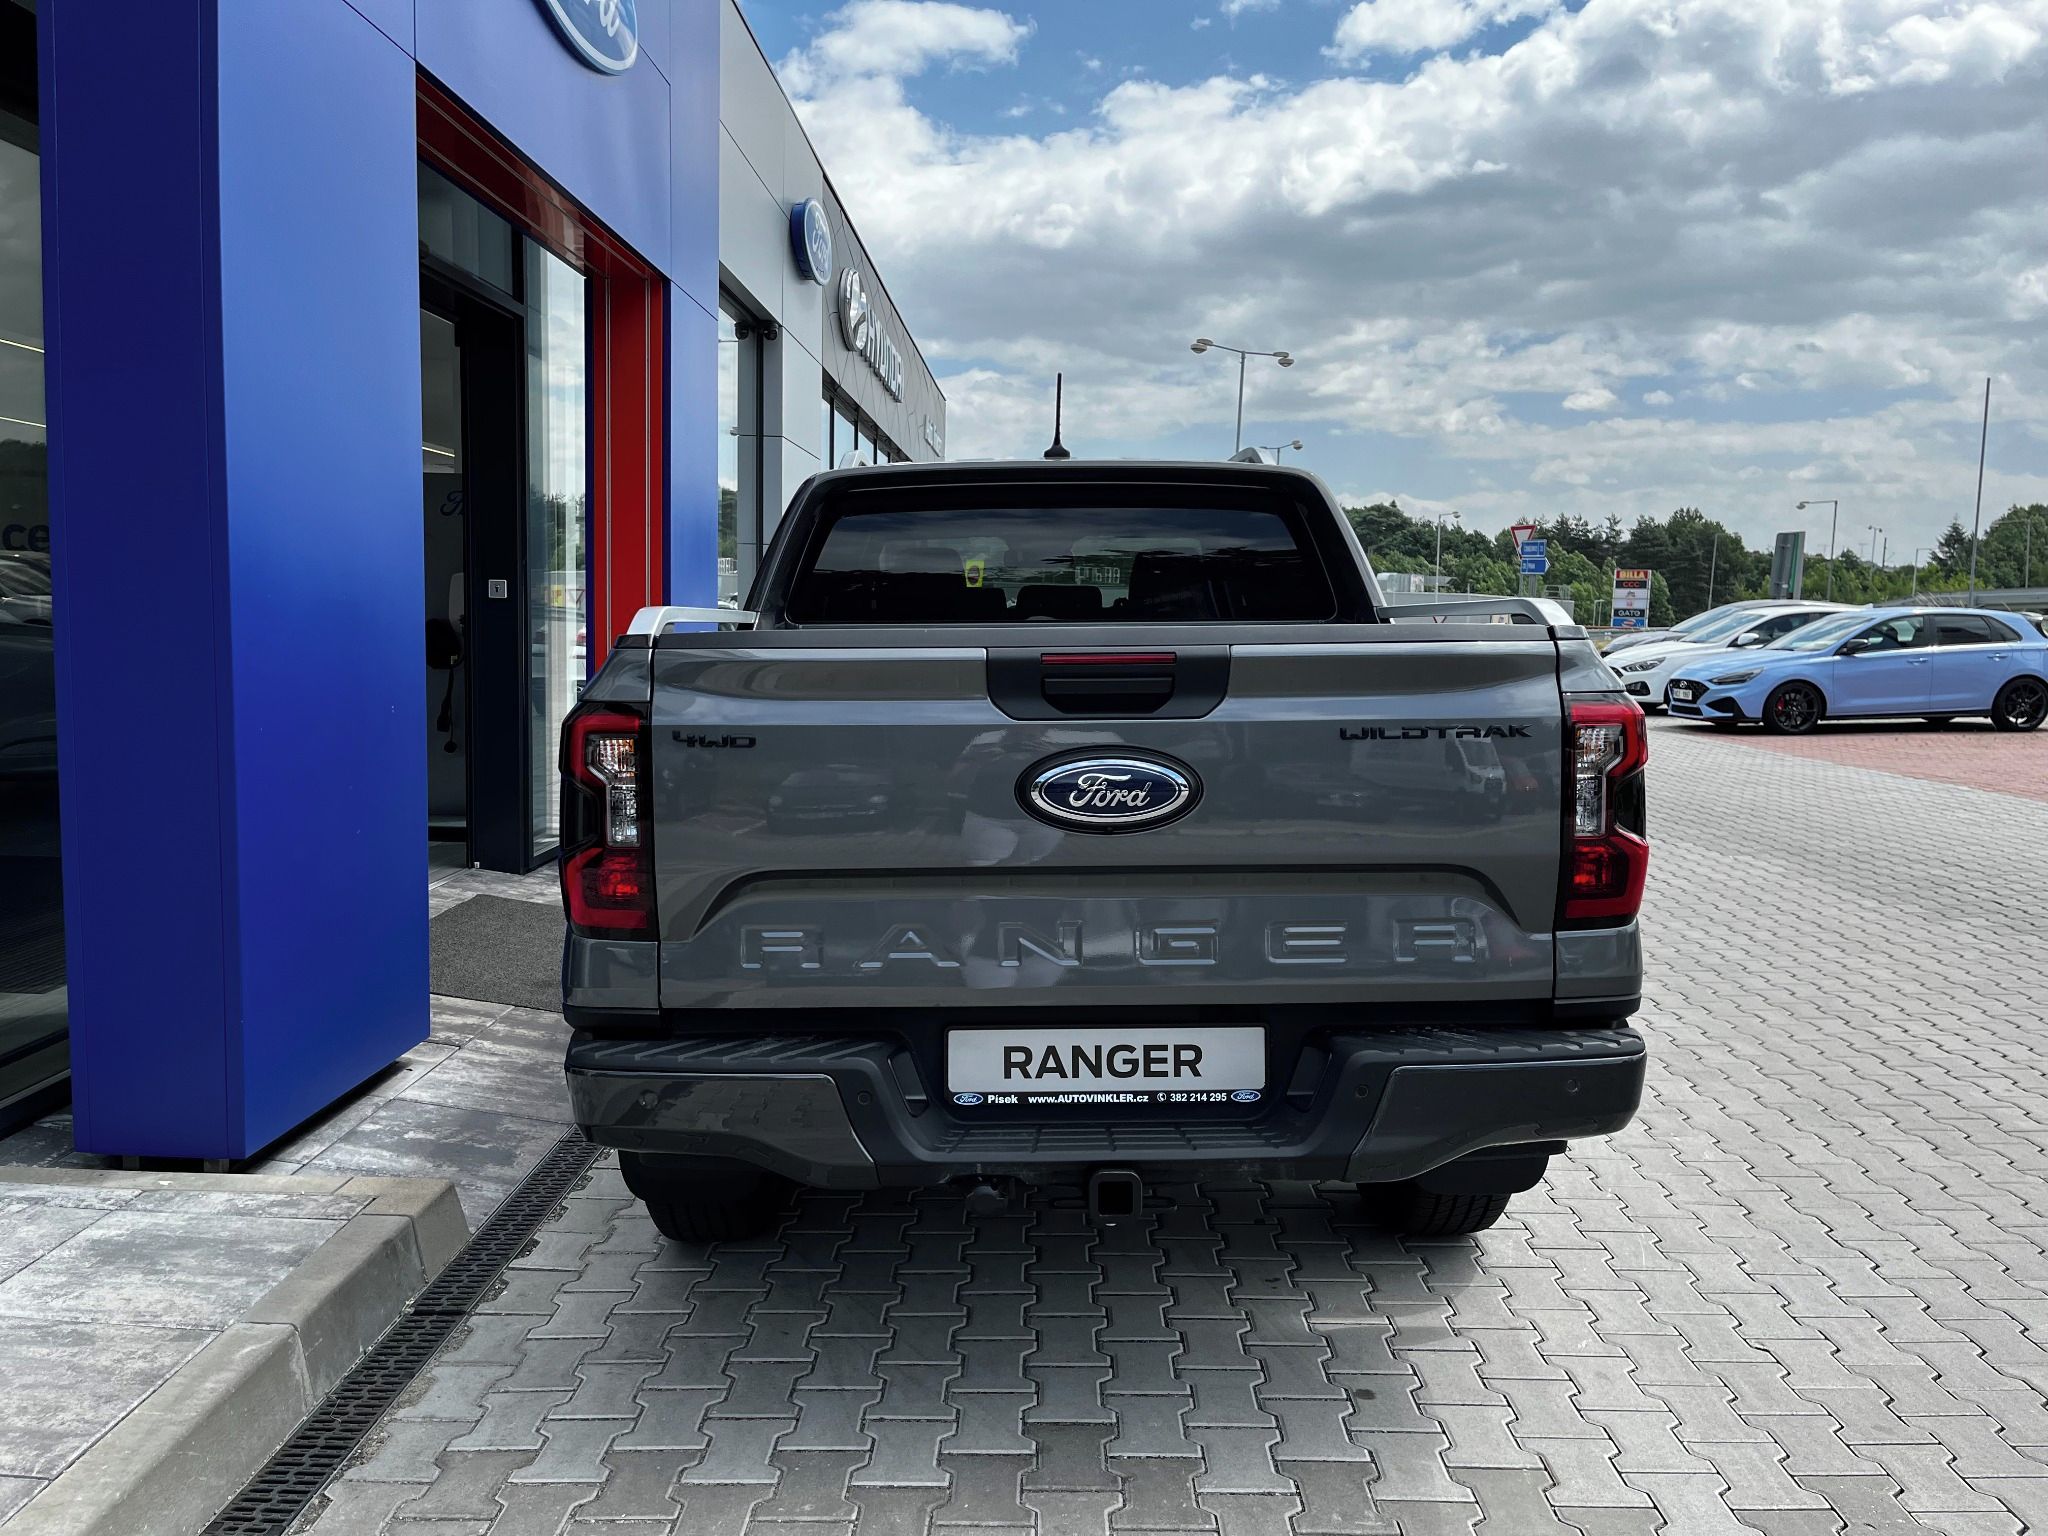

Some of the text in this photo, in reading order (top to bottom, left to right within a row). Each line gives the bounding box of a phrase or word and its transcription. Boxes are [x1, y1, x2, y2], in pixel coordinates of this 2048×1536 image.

[1619, 570, 1645, 579] BILLA
[671, 730, 757, 749] 4WD
[1339, 724, 1534, 741] WILDTRAK
[1068, 772, 1153, 808] Ford
[739, 918, 1477, 969] RANGER
[1003, 1043, 1204, 1080] RANGER
[987, 1092, 1227, 1104] Písek www.AUTOVINKLER.cz 382 214 295
